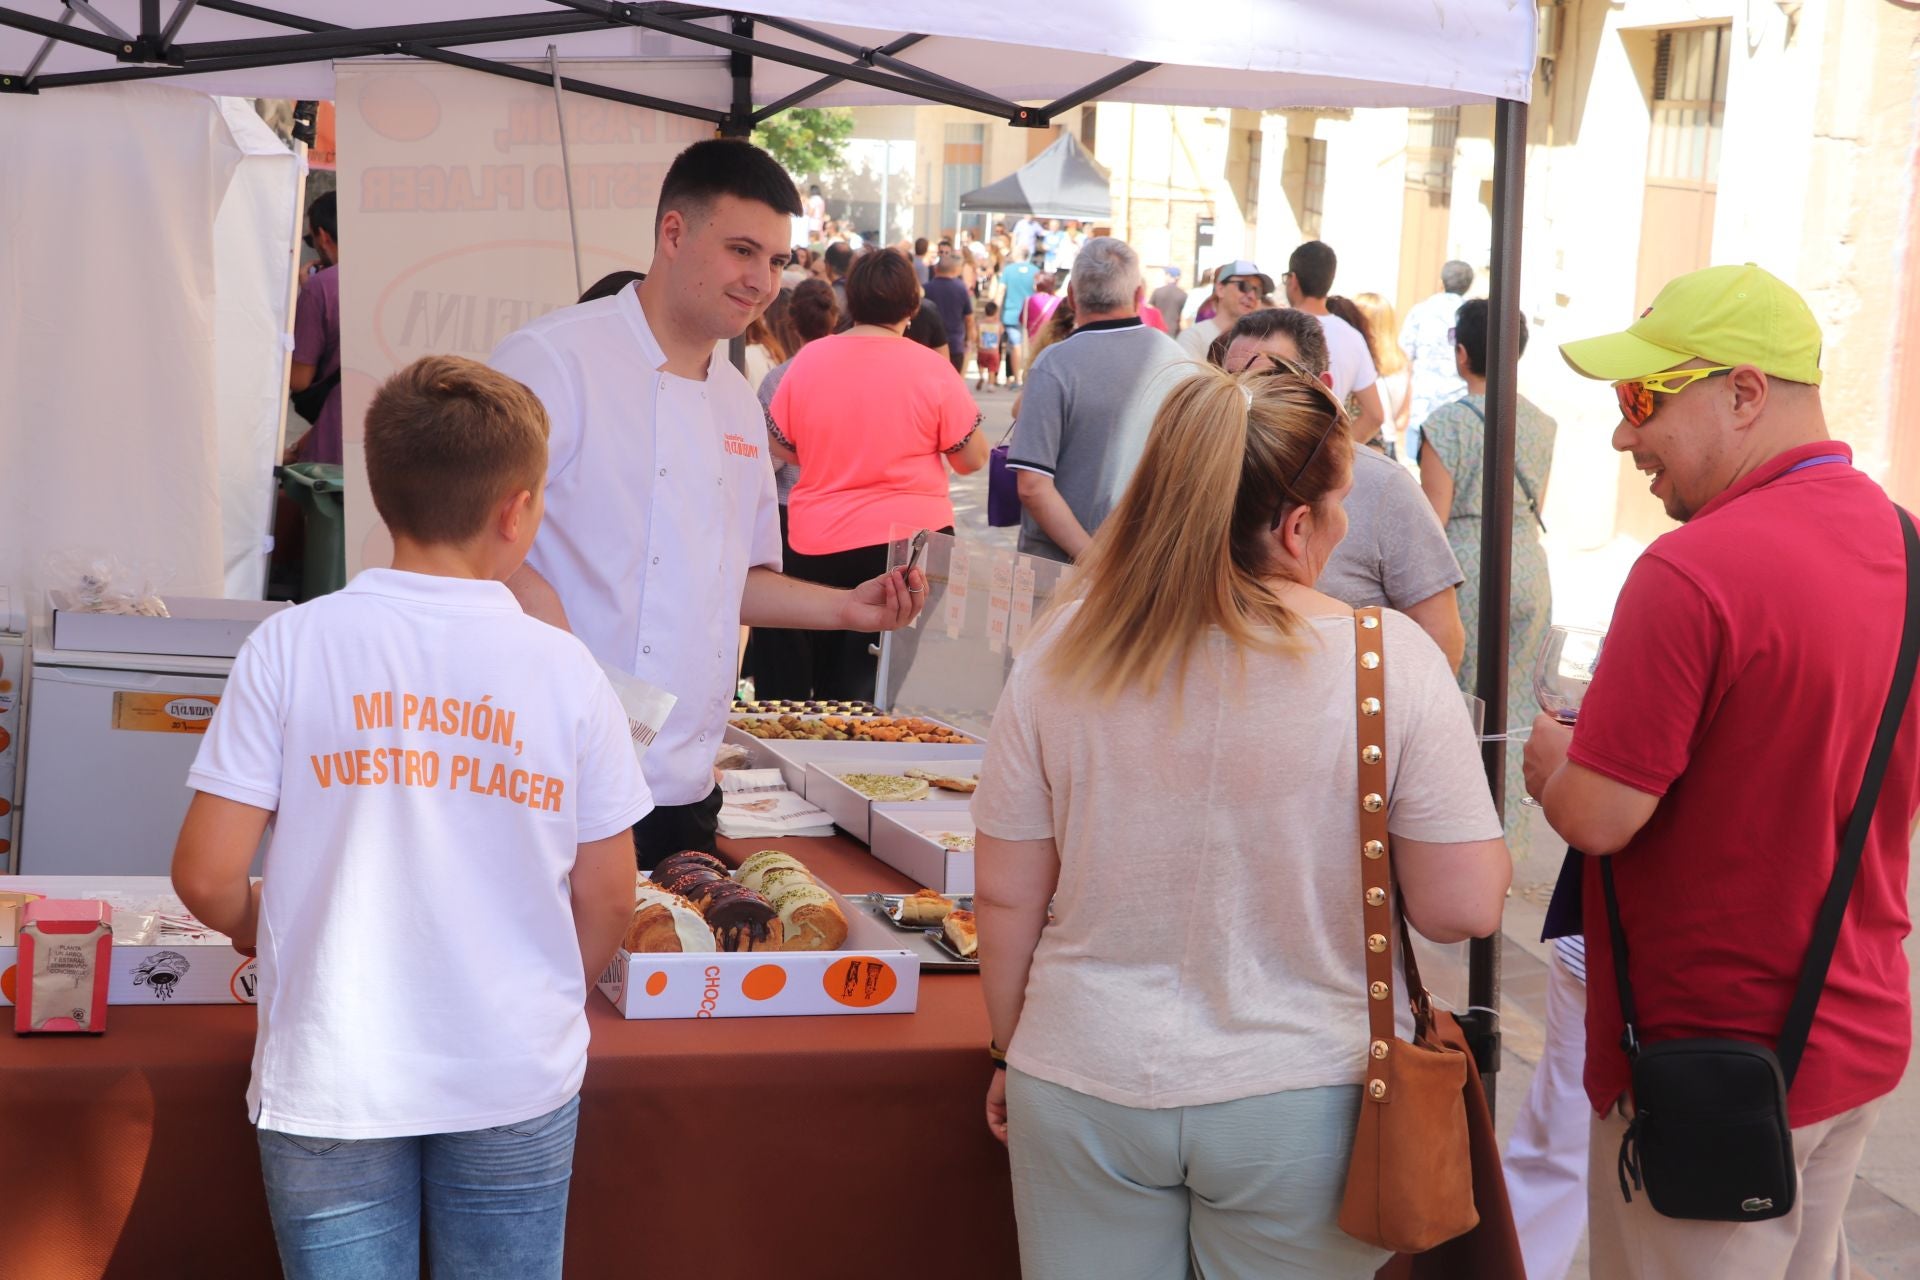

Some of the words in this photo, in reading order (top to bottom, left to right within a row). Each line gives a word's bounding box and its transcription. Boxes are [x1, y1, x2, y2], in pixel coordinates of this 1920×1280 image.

[352, 691, 394, 731] MI
[402, 694, 524, 756] PASIÓN,
[310, 748, 440, 789] VUESTRO
[449, 754, 565, 812] PLACER
